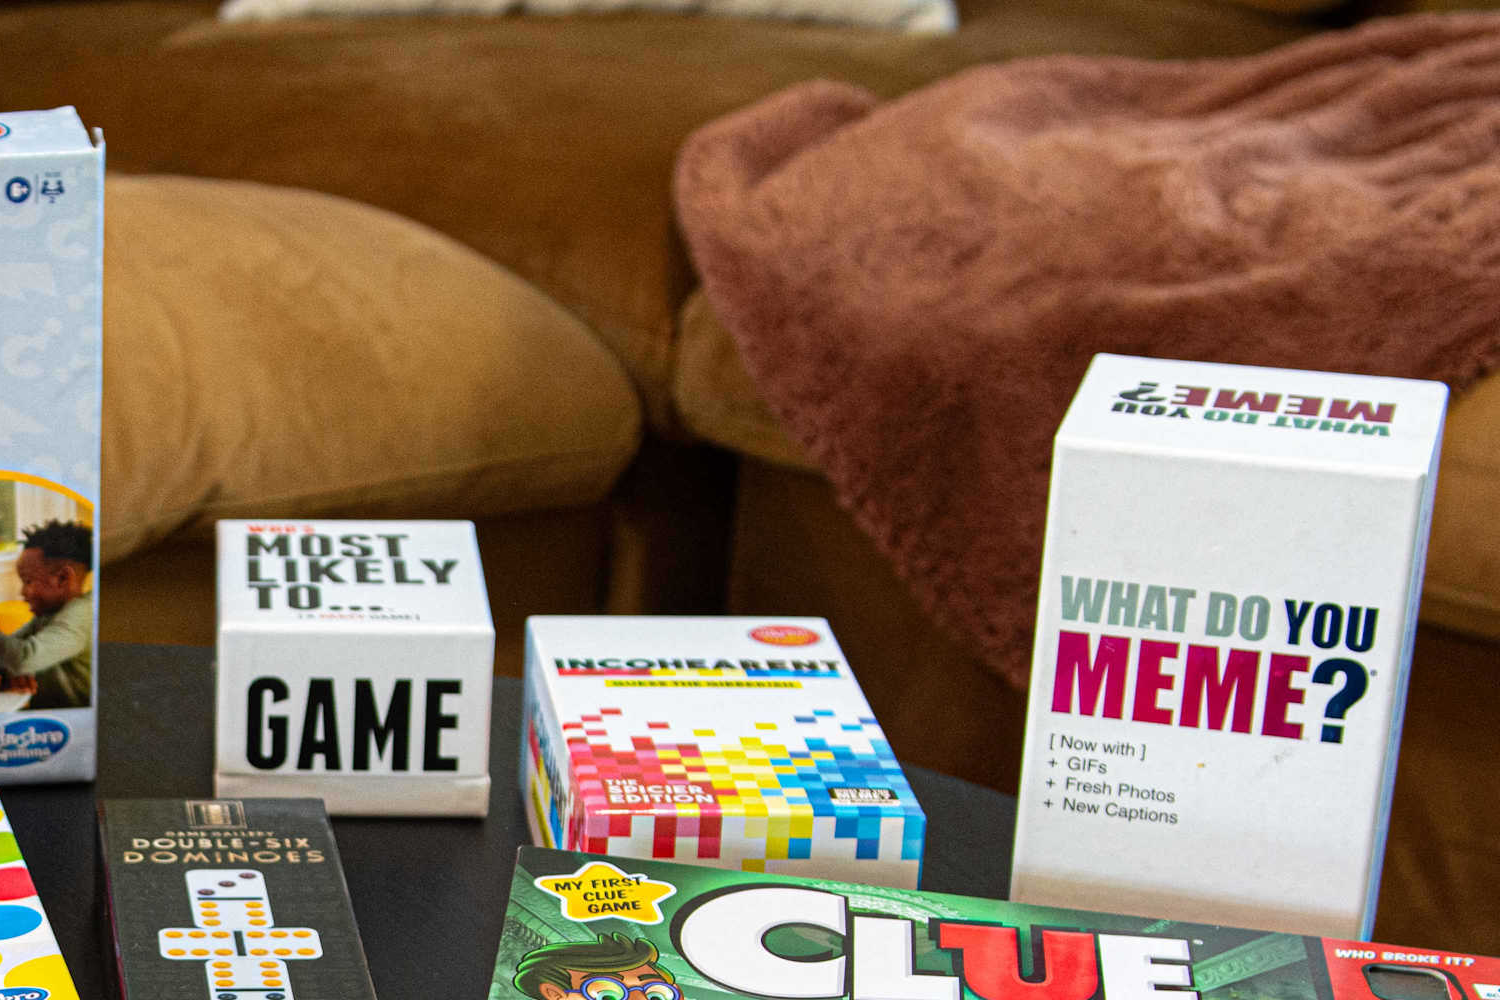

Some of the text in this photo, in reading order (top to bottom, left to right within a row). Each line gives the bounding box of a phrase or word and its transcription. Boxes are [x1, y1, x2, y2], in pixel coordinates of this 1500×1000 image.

[1117, 381, 1398, 424] MEME?
[1110, 400, 1391, 438] WHAT DO YOU
[246, 533, 410, 557] MOST
[247, 558, 459, 585] LIKELY
[248, 584, 383, 611] TO...
[1060, 574, 1381, 653] WHAT DO YOU
[553, 657, 842, 671] INCOHEARENT
[1050, 629, 1370, 746] MEME?
[245, 675, 462, 772] GAME
[1061, 734, 1137, 757] Now with
[1067, 757, 1108, 775] GIFs
[609, 794, 716, 805] EDITION
[1065, 777, 1177, 804] Fresh Photos
[1062, 797, 1179, 825] New Captions
[131, 837, 311, 850] DOUBLE-SIX
[122, 850, 326, 864] DOMINOES
[554, 875, 643, 892] MY FIRST
[583, 889, 627, 902] CLUE
[587, 900, 643, 914] GAME
[1334, 949, 1476, 968] WHO BROKE IT?
